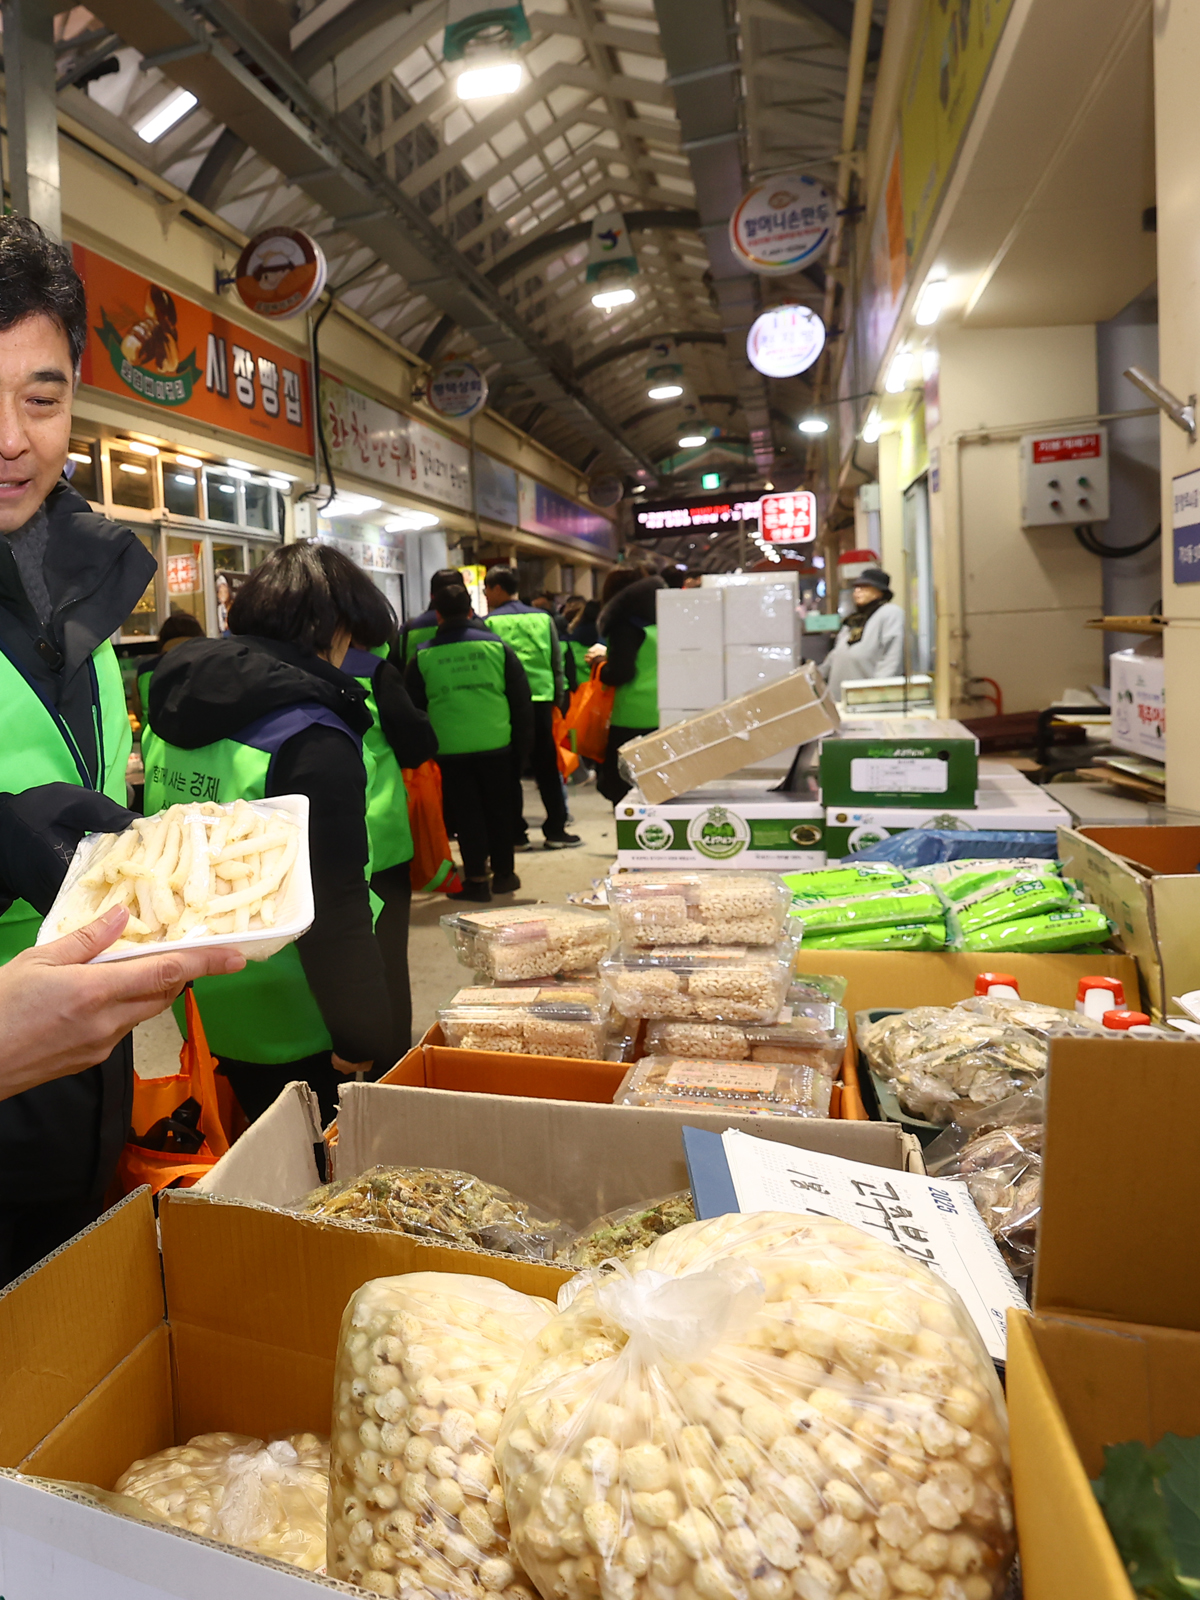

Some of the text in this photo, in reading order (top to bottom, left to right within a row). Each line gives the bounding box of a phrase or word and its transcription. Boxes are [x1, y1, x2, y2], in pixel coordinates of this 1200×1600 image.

[205, 332, 303, 428] 시장빵집
[168, 771, 186, 792] 사는
[928, 1186, 959, 1216] 2025
